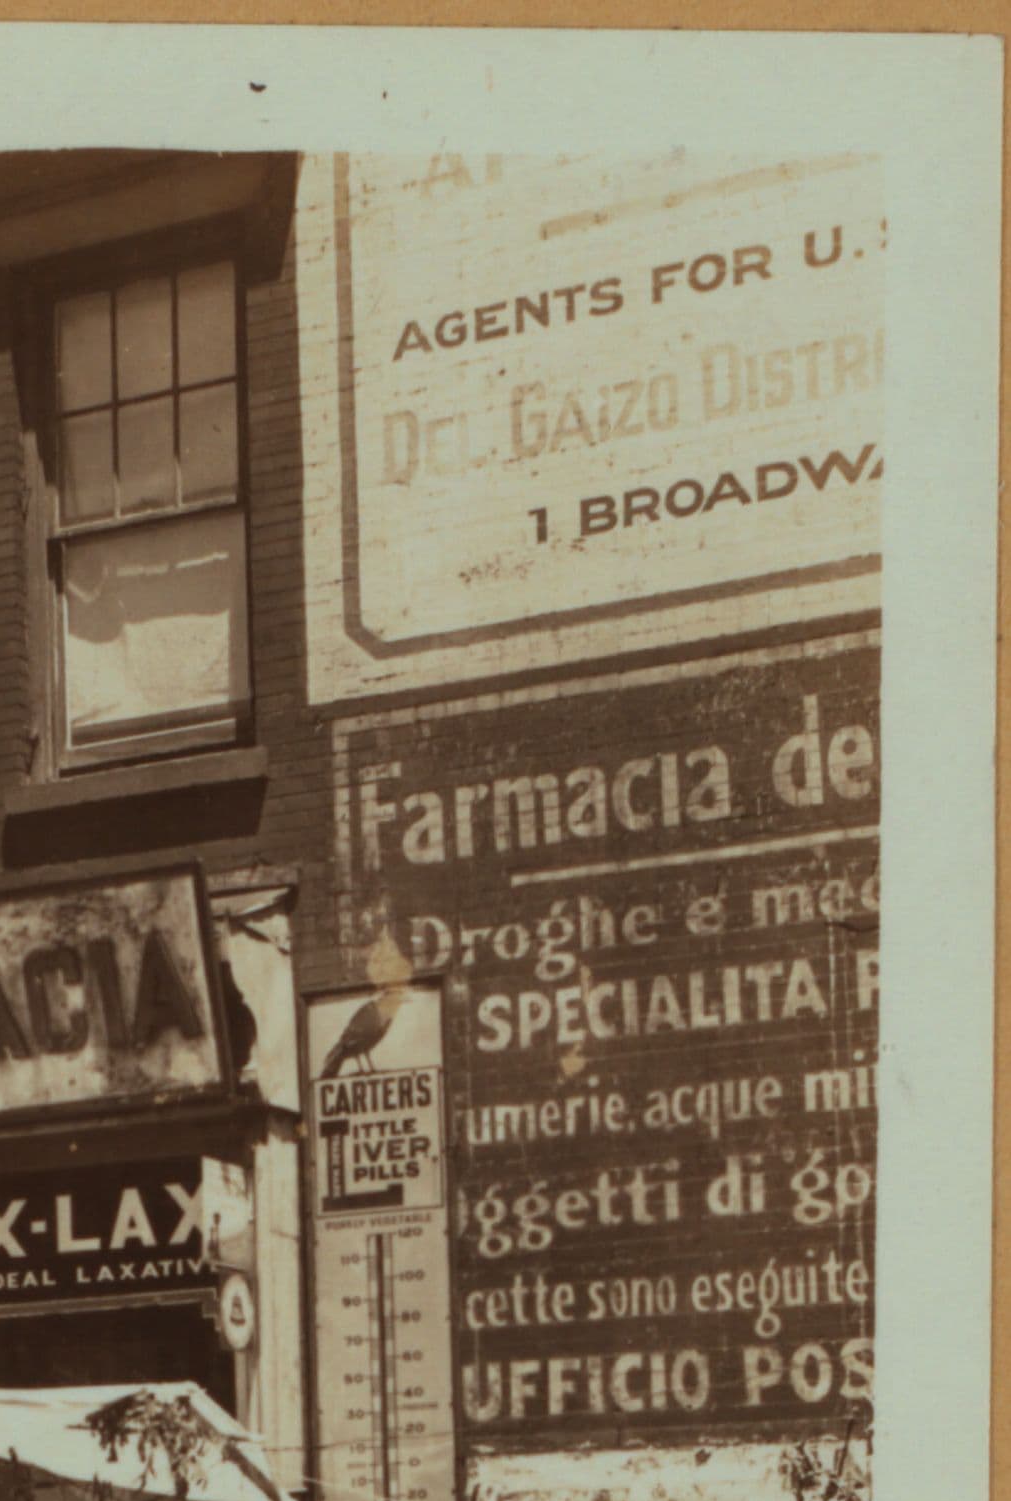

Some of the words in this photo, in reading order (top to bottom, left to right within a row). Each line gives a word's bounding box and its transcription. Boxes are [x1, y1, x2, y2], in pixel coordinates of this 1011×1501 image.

[392, 276, 625, 363] AGENTS
[649, 244, 774, 305] FOR
[528, 506, 550, 544] 1
[358, 745, 731, 870] Farmacia
[409, 897, 658, 981] Droghe
[477, 956, 827, 1052] SPECIALITA
[644, 1072, 782, 1140] acque
[353, 1161, 420, 1182] PILLS
[707, 1154, 765, 1217] di
[588, 1276, 677, 1321] sono
[692, 1249, 869, 1338] eseguite
[462, 1350, 711, 1421] UFFICIO
